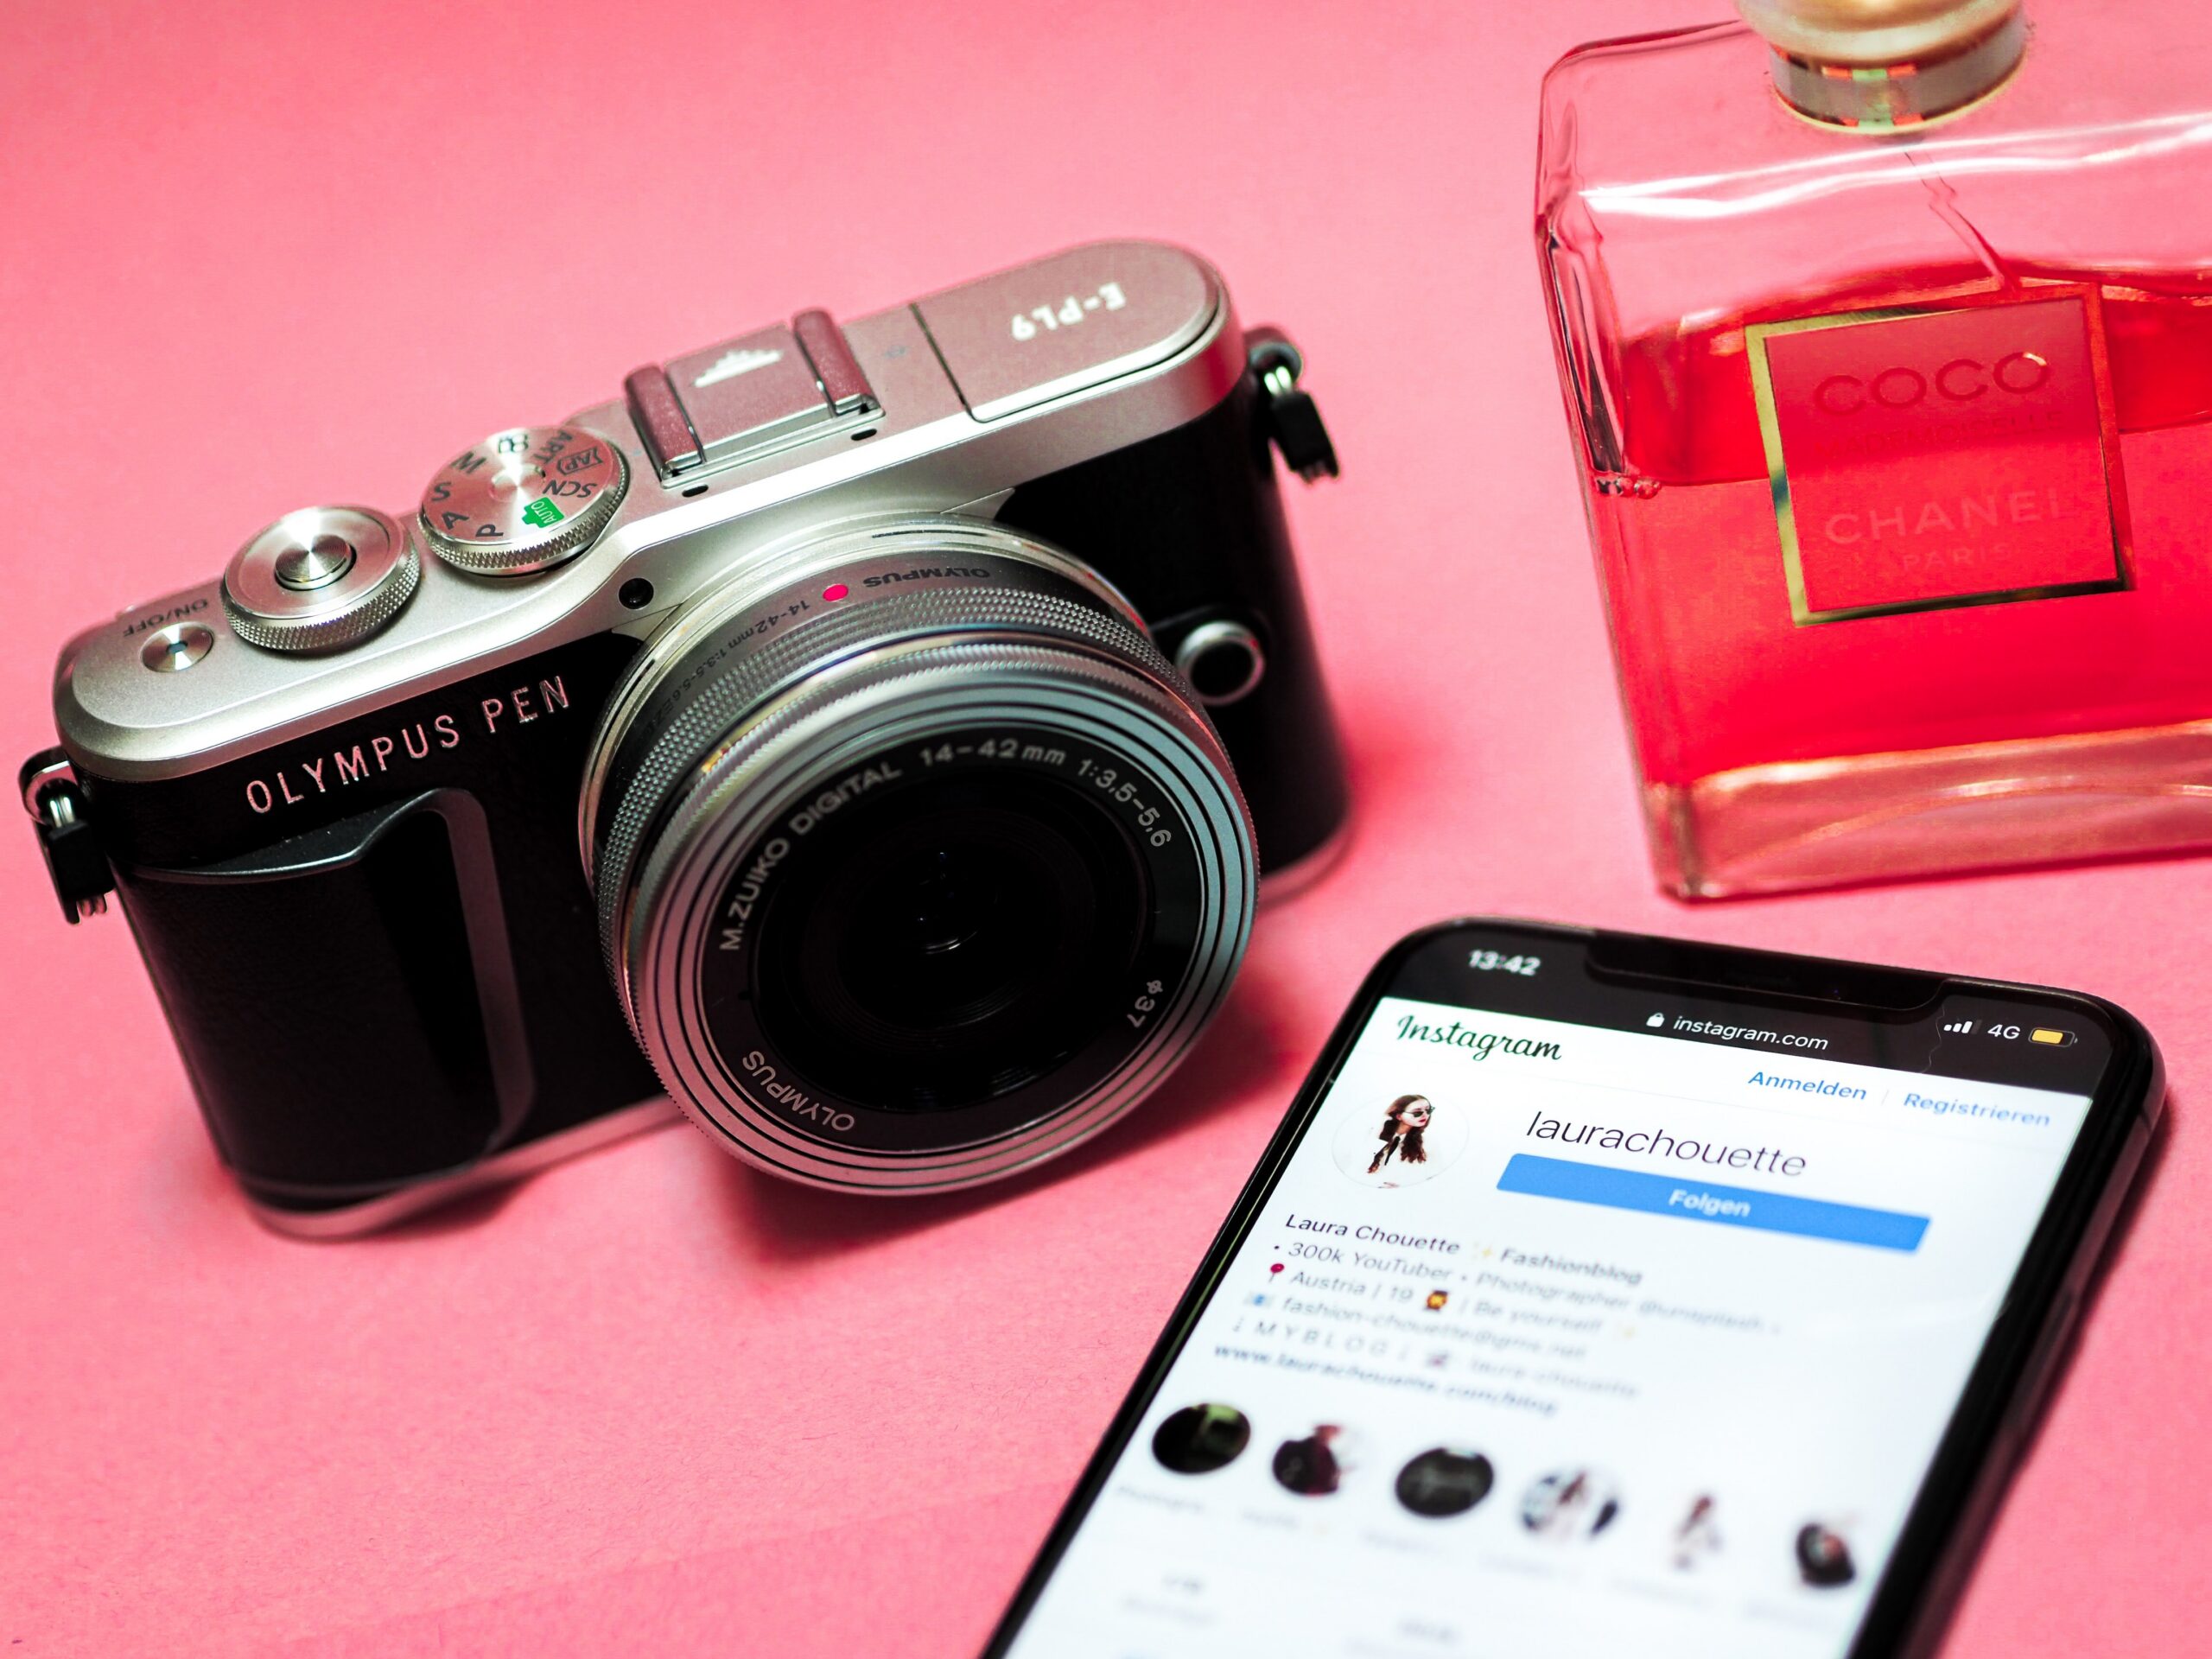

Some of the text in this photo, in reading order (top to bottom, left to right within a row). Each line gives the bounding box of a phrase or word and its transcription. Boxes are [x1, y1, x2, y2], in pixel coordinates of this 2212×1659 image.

[1011, 282, 1126, 340] E-PL9
[1815, 351, 2050, 416] COCO
[450, 451, 487, 474] M
[533, 430, 574, 465] ART
[432, 481, 452, 501] S
[543, 479, 598, 499] SCN
[441, 511, 470, 530] A
[475, 524, 504, 537] P
[531, 501, 556, 524] AUTO
[862, 566, 990, 589] OLYMPUS
[123, 599, 208, 637] ON/OFF
[728, 600, 810, 649] 14-42mm
[245, 675, 569, 813] OLYMPUS PEN
[719, 837, 790, 950] M.ZUIKO
[788, 760, 903, 836] DIGITAL
[918, 737, 1066, 766] 14-42mm
[1469, 949, 1541, 976] 13:42
[1397, 1014, 1563, 1062] Instagram
[1673, 1014, 1829, 1051] instagram.com
[1987, 1023, 2021, 1040] 4G
[741, 1050, 855, 1132] OLYMPUS
[1747, 1071, 2051, 1128] Anmelden Registrieren
[1526, 1110, 1807, 1177] laurachouette
[1668, 1189, 1751, 1219] Folgen
[1285, 1213, 1644, 1287] Laura Chouette Fashionblog
[1287, 1242, 1344, 1264] 300k
[1351, 1251, 1452, 1282] YouTuber
[1290, 1270, 1367, 1296] Austria
[1389, 1285, 1415, 1303] 19
